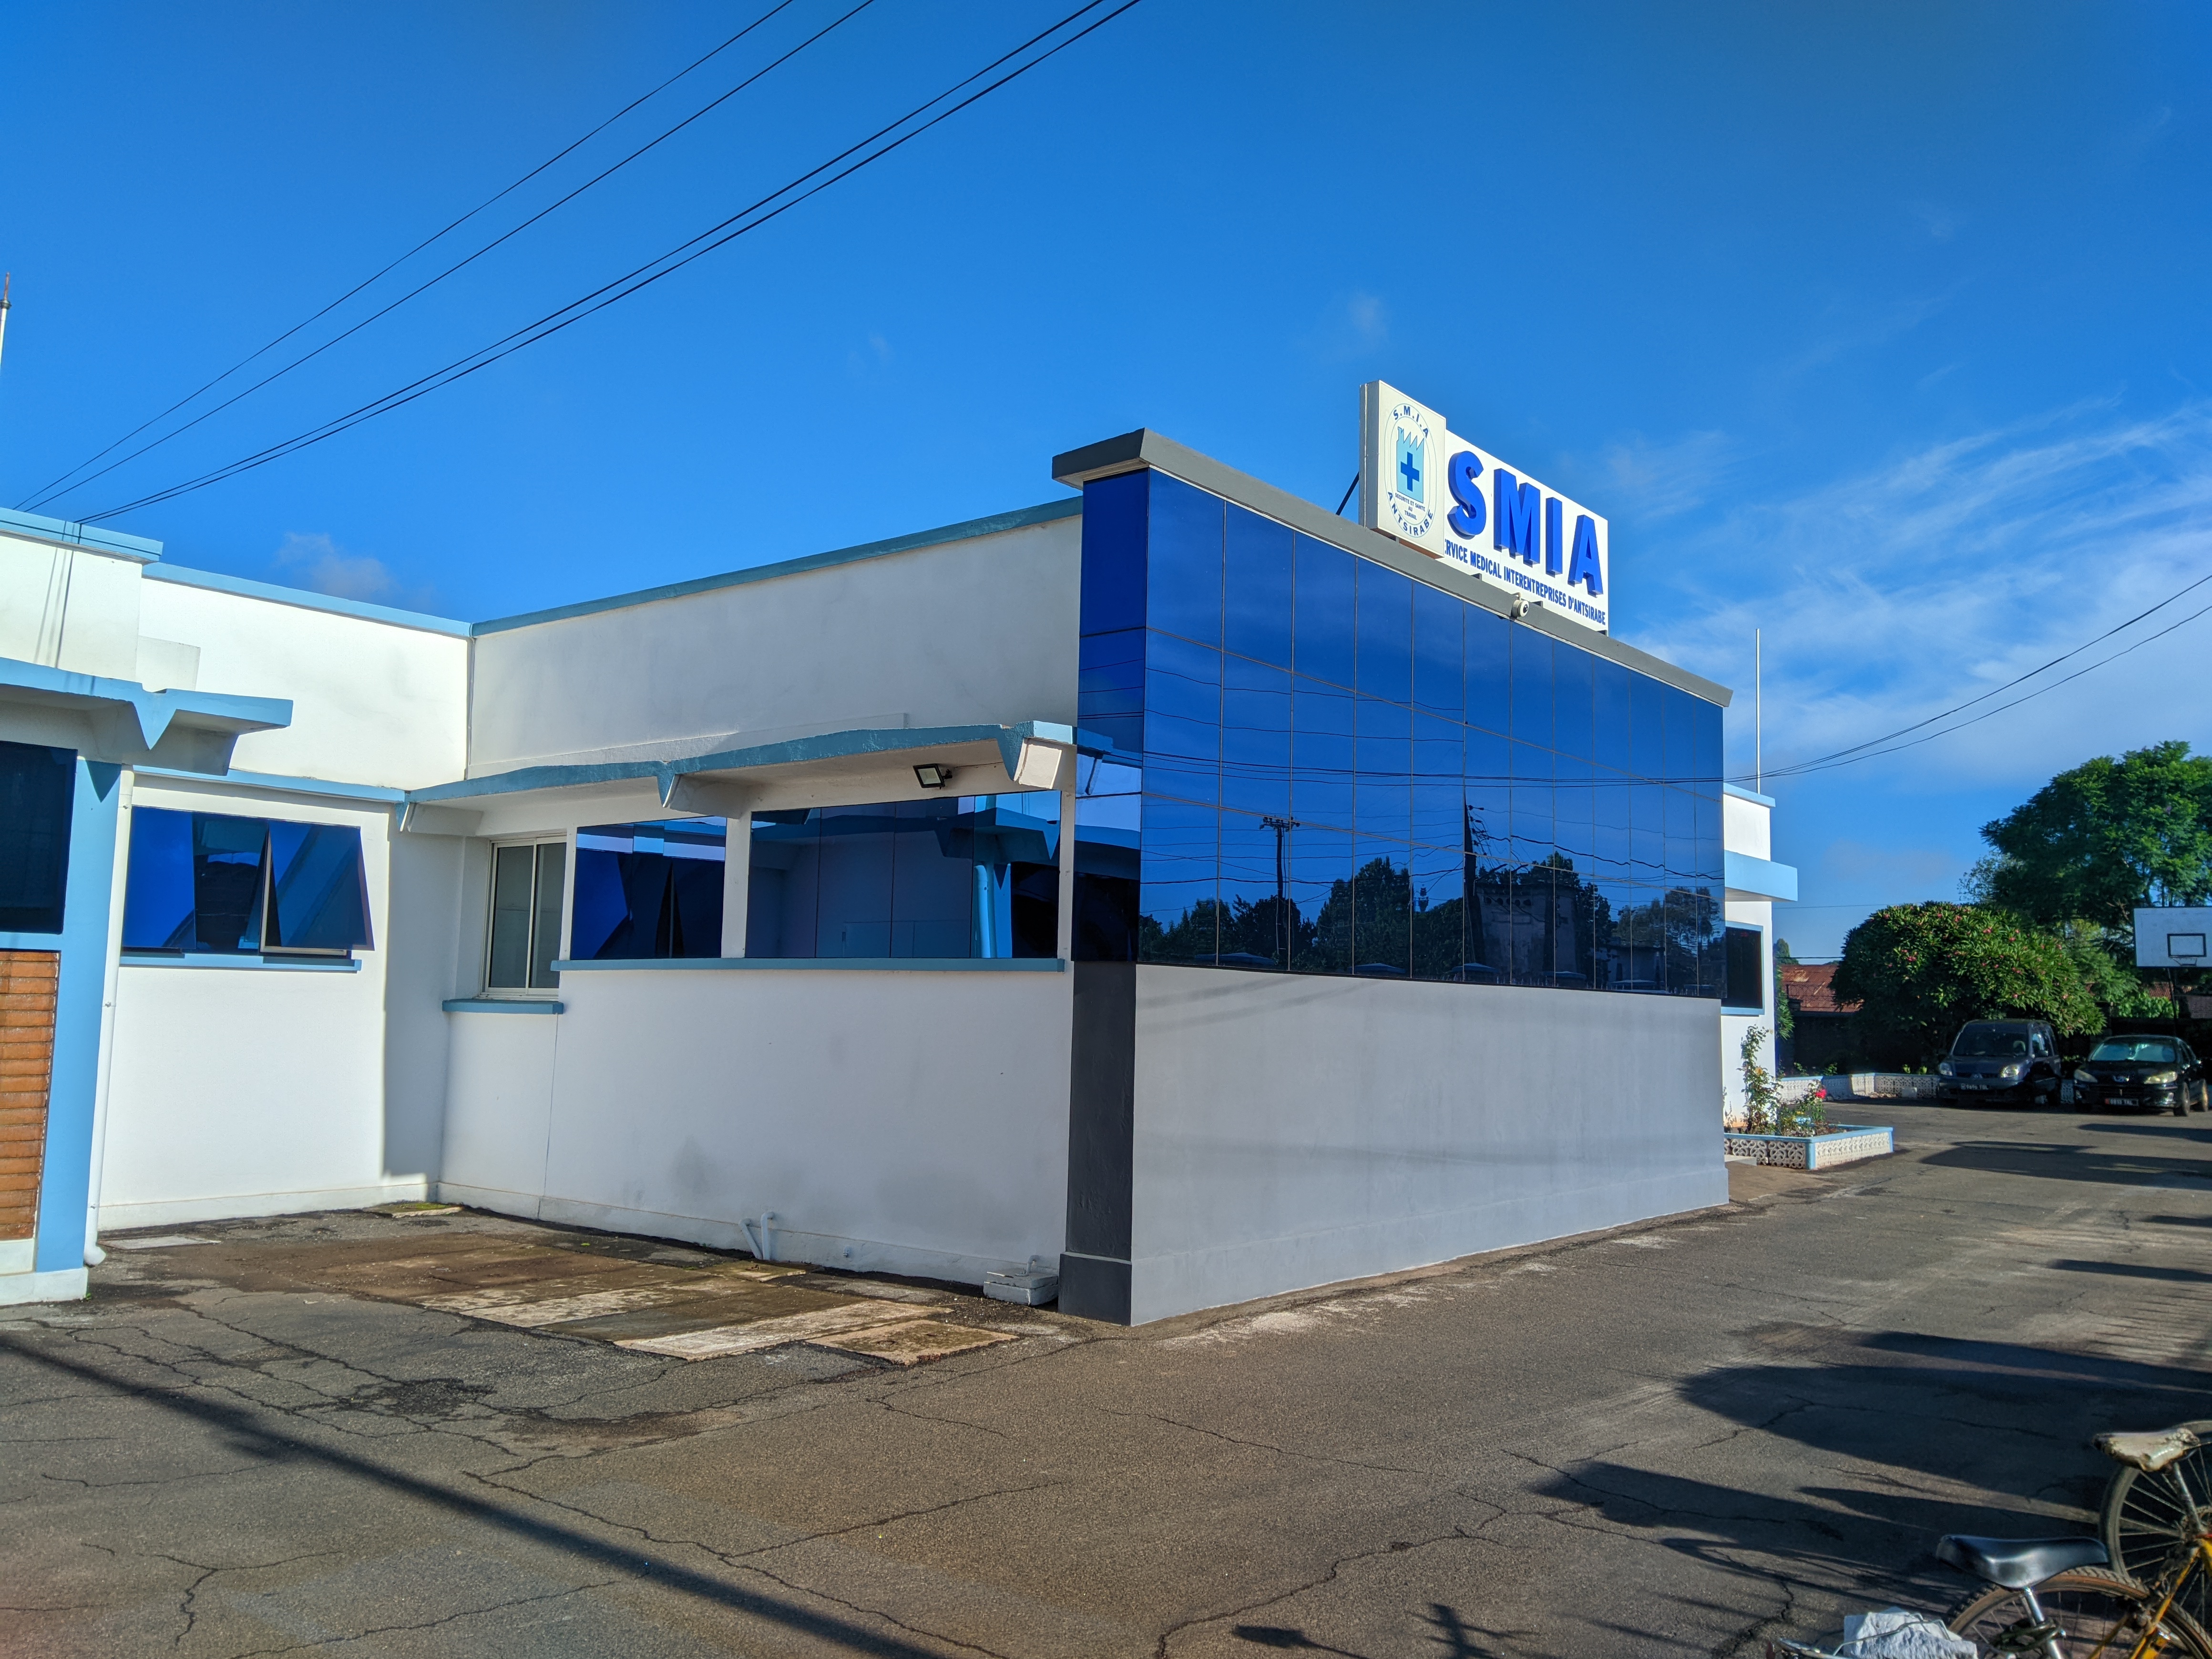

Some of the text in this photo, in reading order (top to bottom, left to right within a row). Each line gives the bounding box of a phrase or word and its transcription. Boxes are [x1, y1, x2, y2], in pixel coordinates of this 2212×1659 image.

[1388, 492, 1433, 536] ANTSIRABE
[1447, 451, 1604, 598] SMIA
[1445, 538, 1606, 625] RVICE MEDICAL INTERENTREPRISES D'ANTSIRABE
